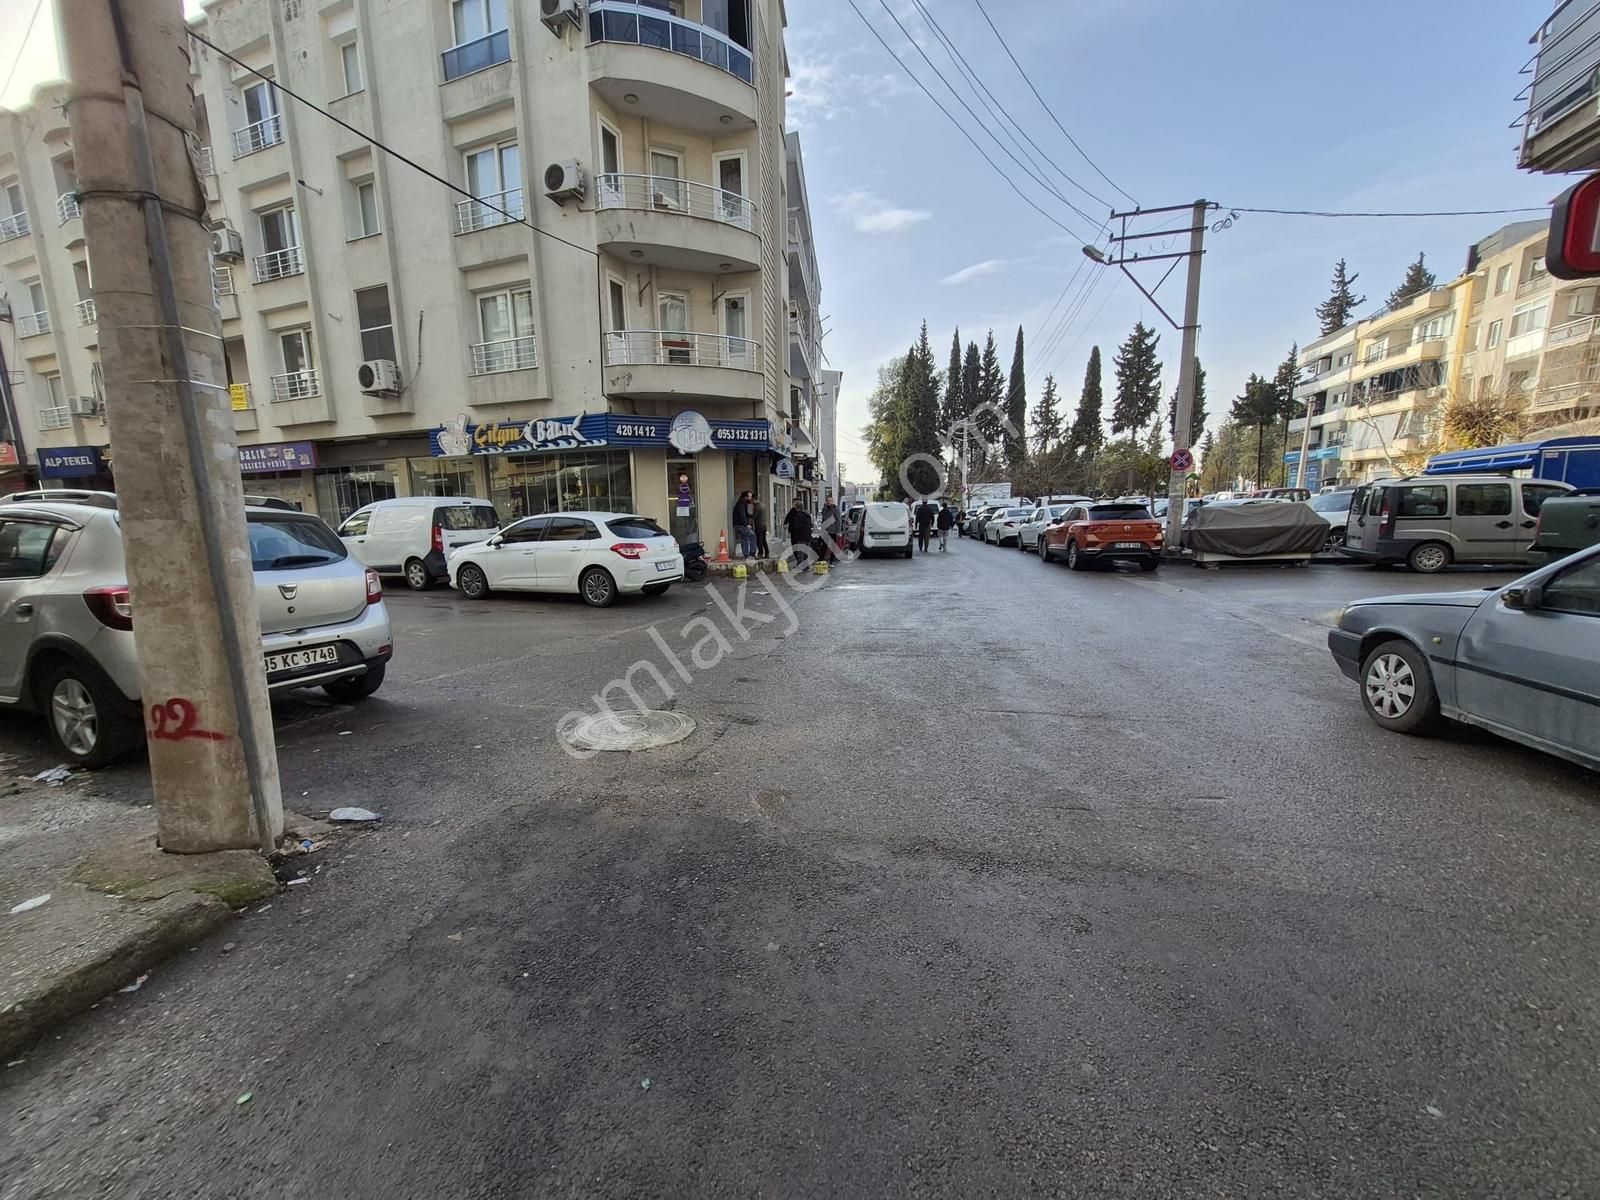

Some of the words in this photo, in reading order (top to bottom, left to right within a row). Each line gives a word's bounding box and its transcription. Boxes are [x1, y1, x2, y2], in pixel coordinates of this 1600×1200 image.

[616, 424, 633, 436] 420
[717, 428, 735, 440] 0553
[735, 429, 749, 440] 132
[45, 457, 61, 467] ALP
[62, 455, 93, 466] TEKEL
[282, 653, 299, 668] KC
[303, 647, 335, 663] 3748
